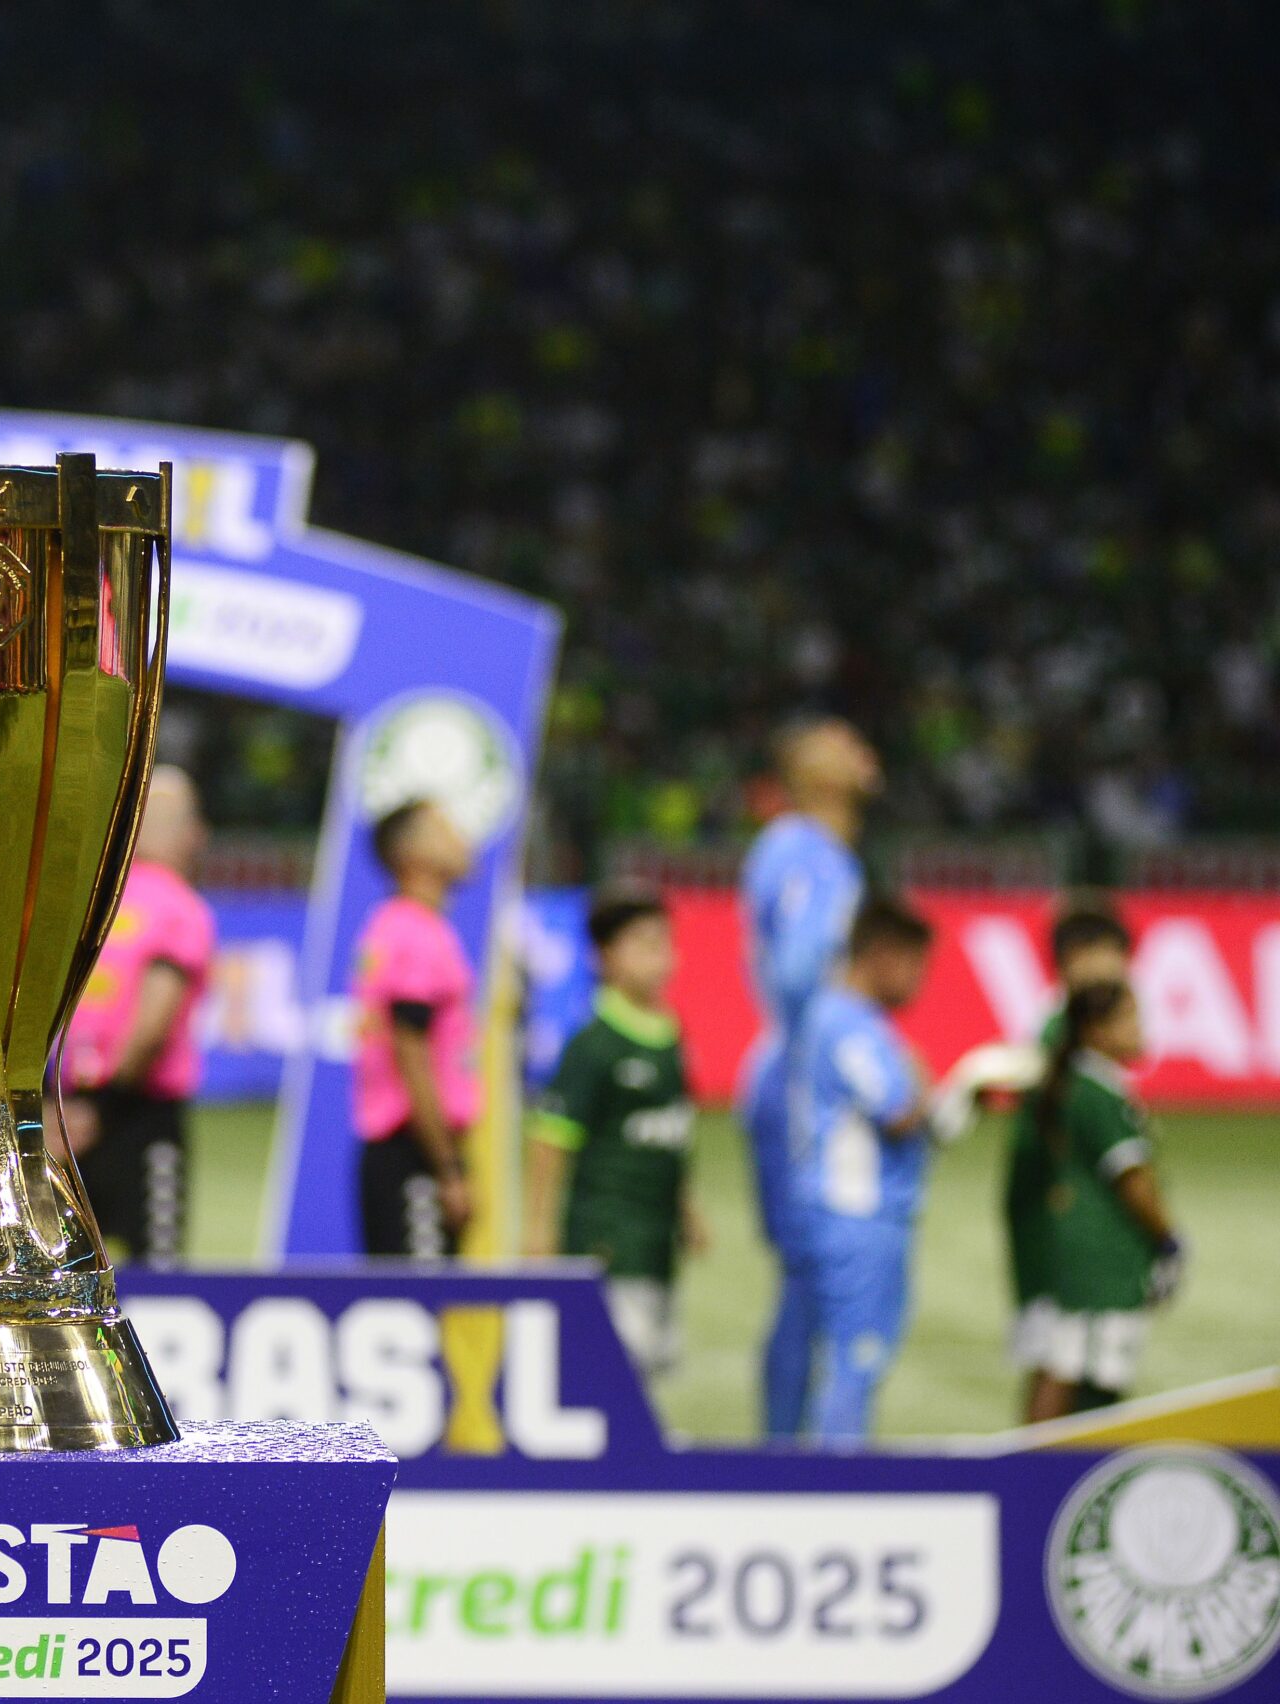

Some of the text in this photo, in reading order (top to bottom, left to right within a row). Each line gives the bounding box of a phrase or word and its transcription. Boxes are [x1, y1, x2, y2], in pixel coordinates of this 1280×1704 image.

[385, 1544, 930, 1640] redi 2025
[77, 1638, 192, 1677] 2025
